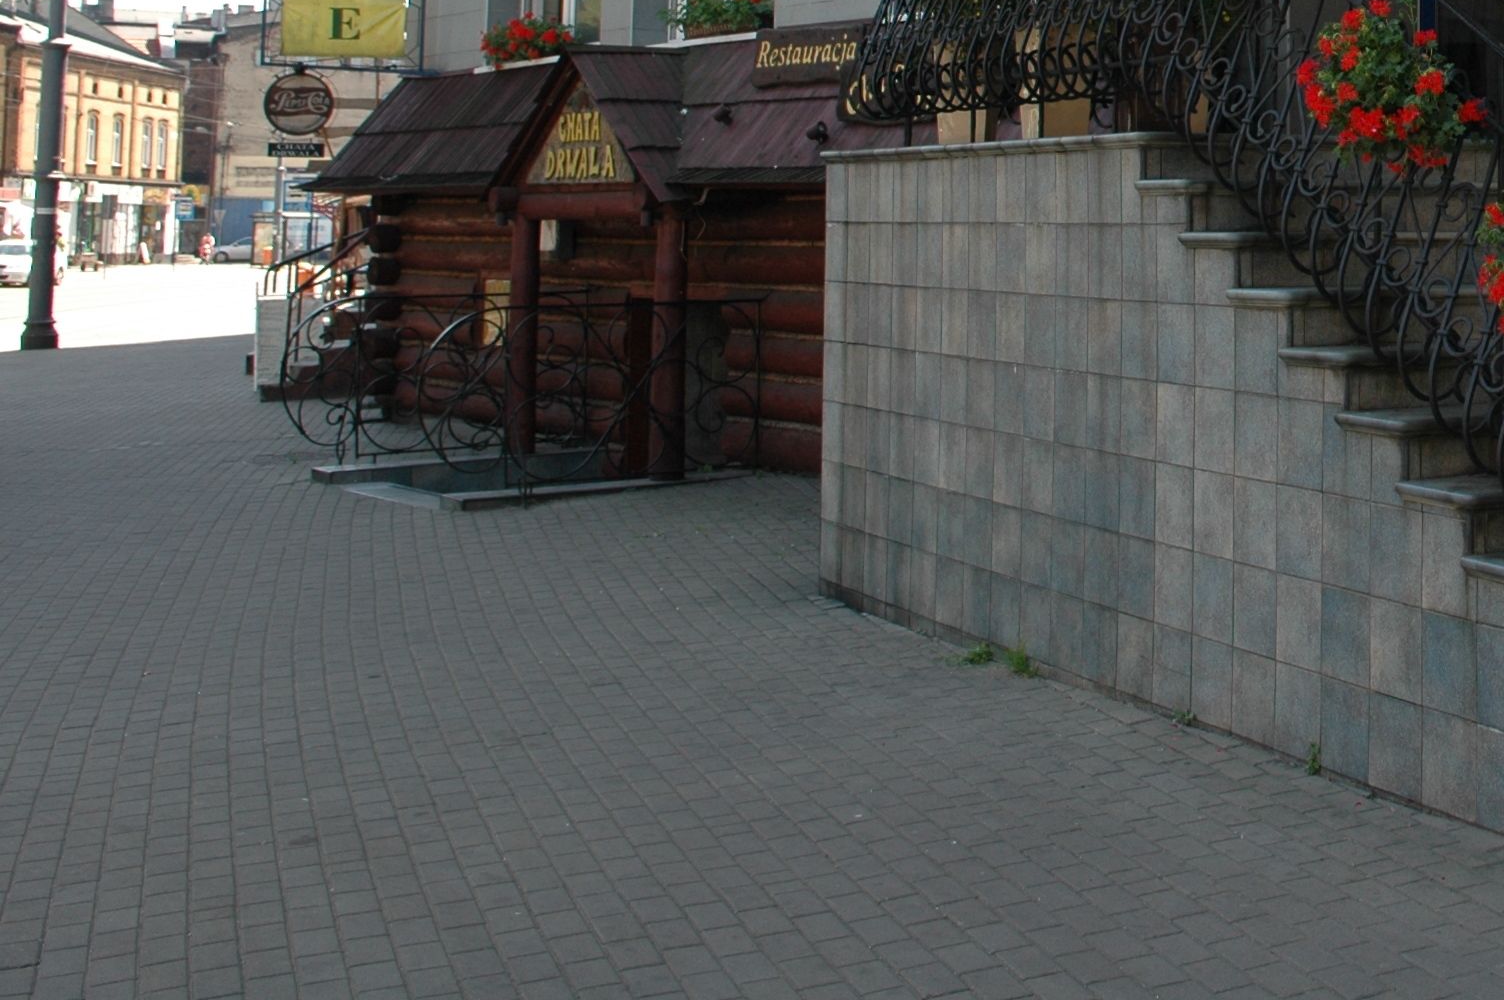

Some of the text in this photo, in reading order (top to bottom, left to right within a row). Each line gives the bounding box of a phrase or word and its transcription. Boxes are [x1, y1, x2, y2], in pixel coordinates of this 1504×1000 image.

[756, 33, 857, 71] Restauracja
[559, 111, 601, 143] CHATA
[544, 145, 616, 180] DRWALA
